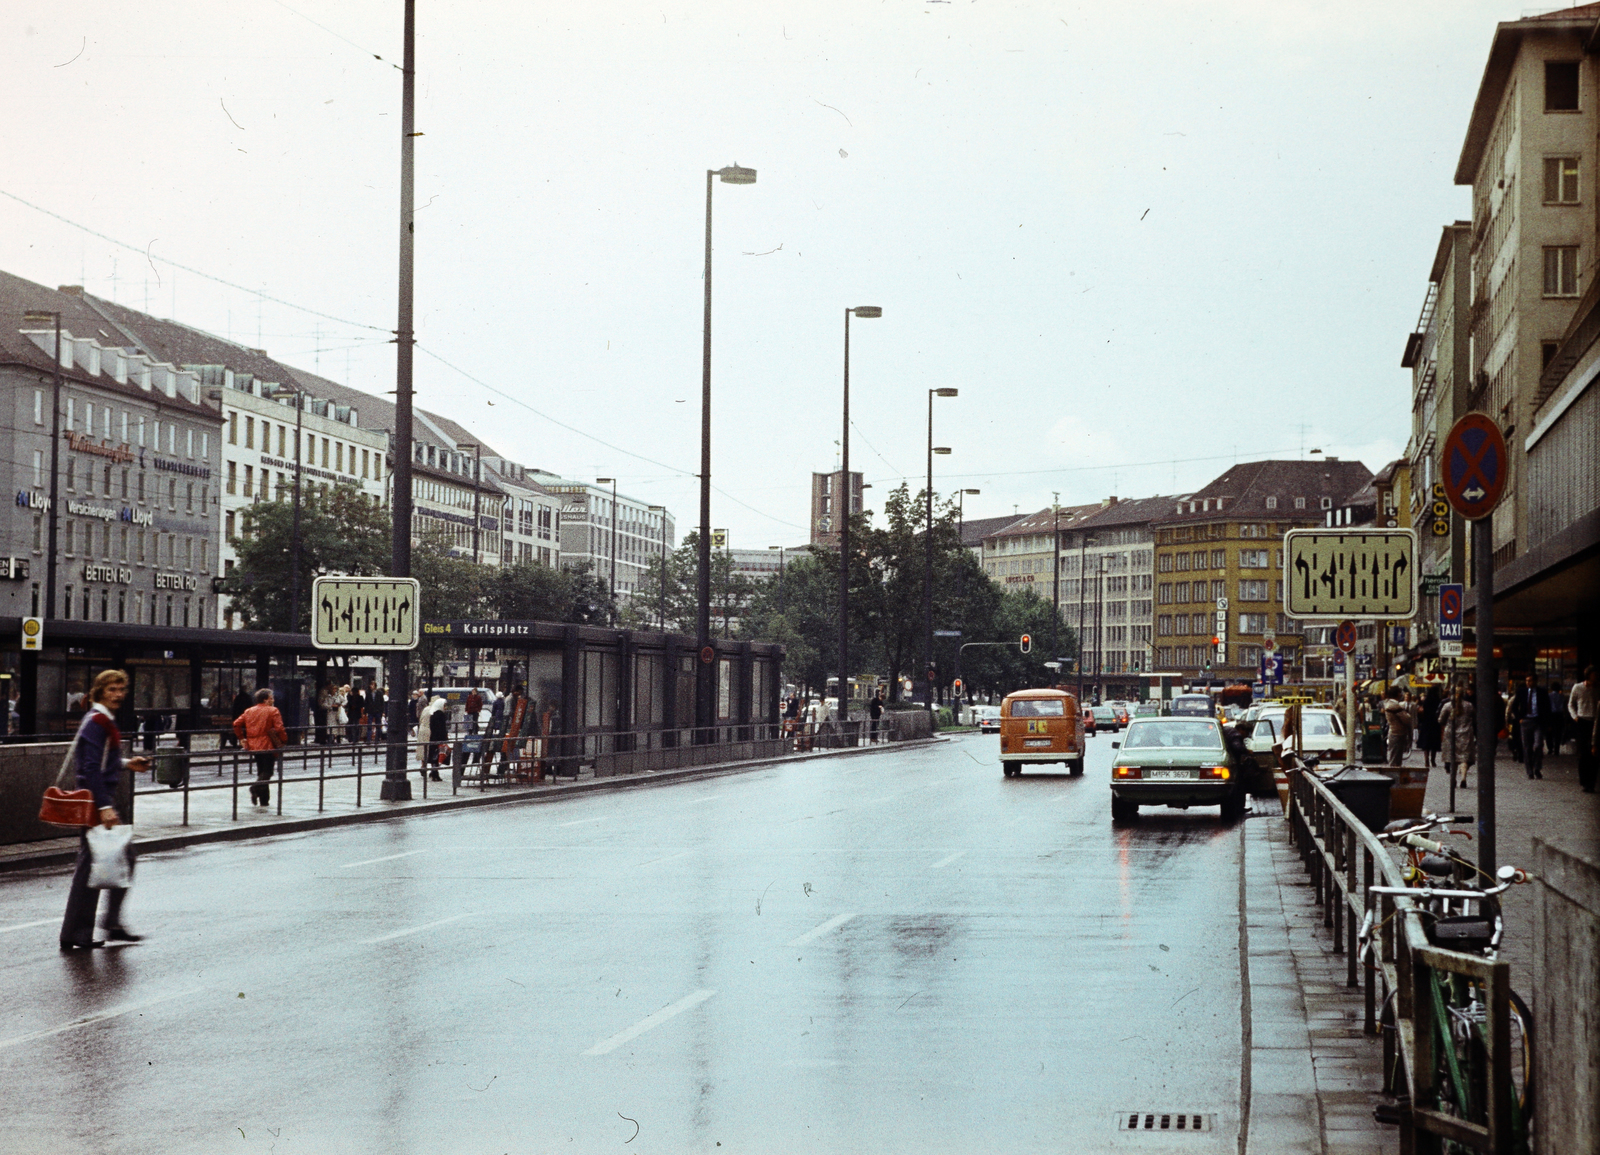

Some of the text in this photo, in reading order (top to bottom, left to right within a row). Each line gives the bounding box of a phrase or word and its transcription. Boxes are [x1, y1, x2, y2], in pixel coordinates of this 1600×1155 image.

[29, 491, 51, 513] Lloy
[67, 500, 153, 528] Versicherungen Lloyd
[86, 565, 132, 584] BETTEN RID
[156, 573, 184, 589] BETTEN
[185, 576, 198, 591] RID
[424, 623, 529, 635] Gleis 4 Karlsplatz
[1441, 623, 1461, 636] TAXI
